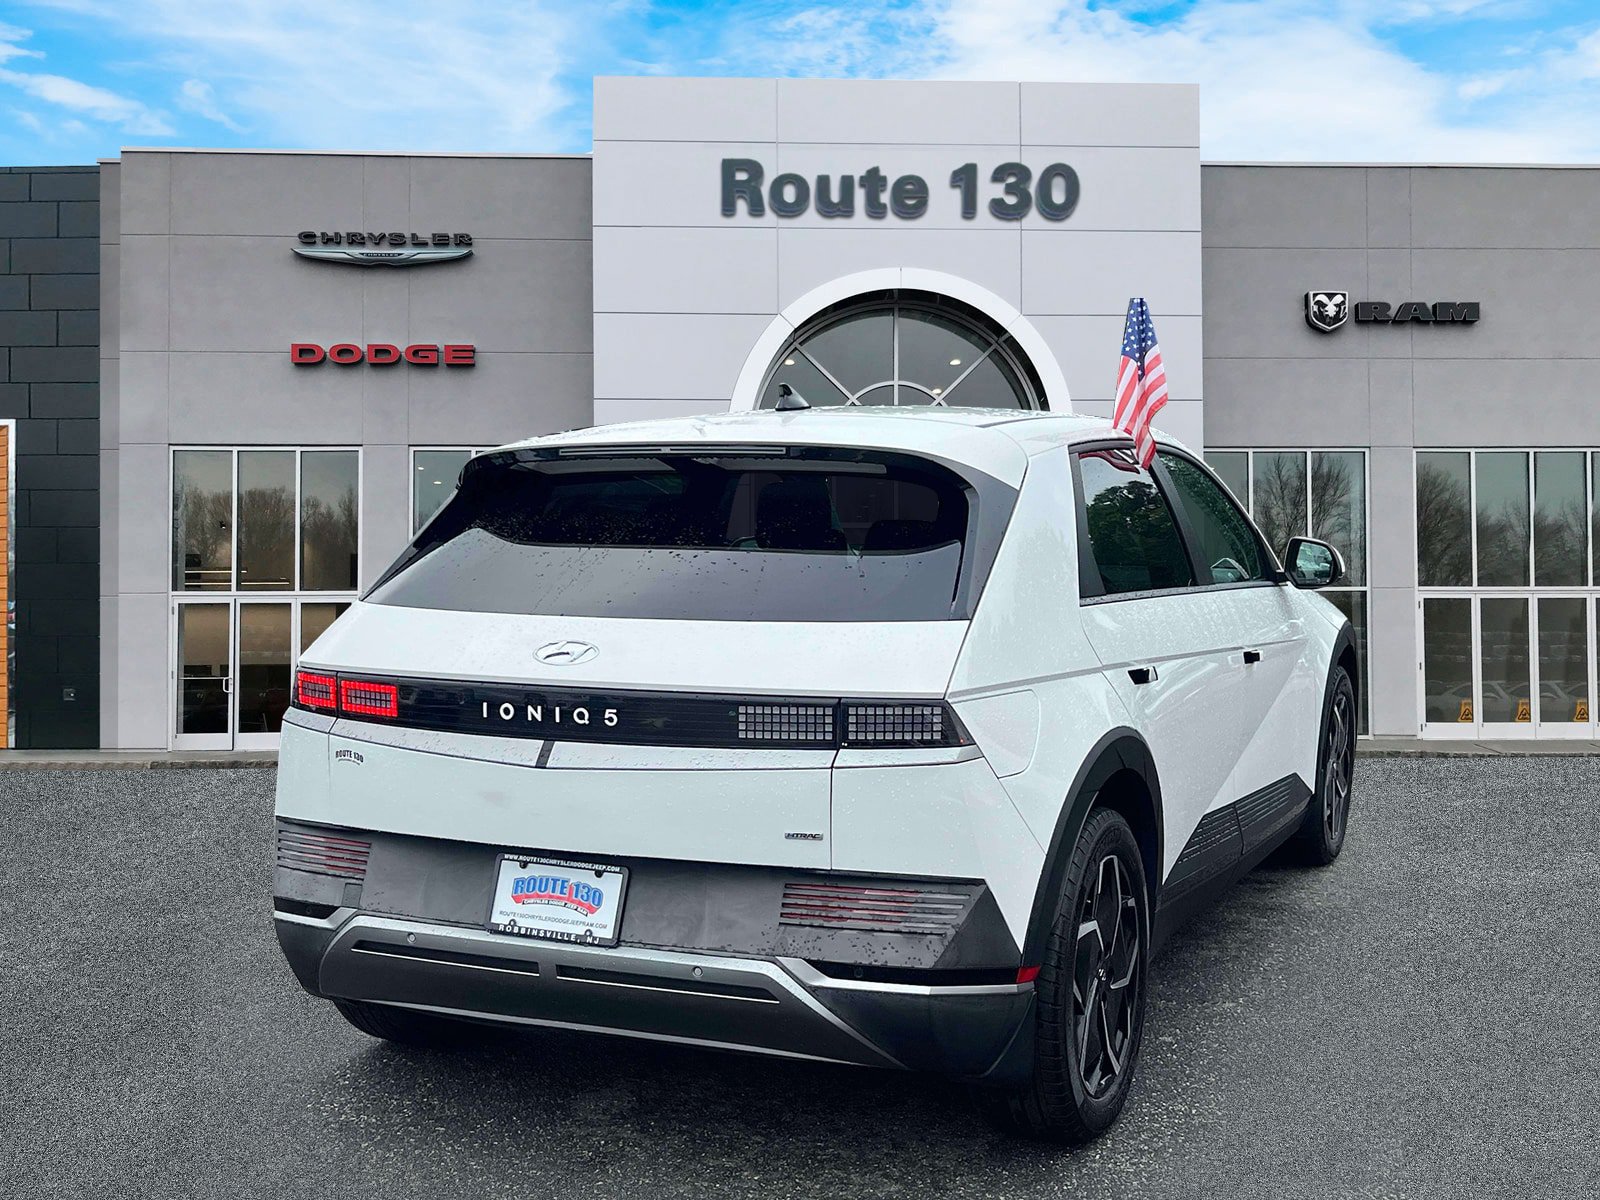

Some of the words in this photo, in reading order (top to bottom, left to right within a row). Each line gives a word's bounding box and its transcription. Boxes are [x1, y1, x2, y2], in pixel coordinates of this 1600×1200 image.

[720, 157, 930, 218] Route
[949, 161, 1081, 221] 130
[298, 231, 473, 246] CHRYSLER
[1354, 302, 1480, 324] RAM
[290, 343, 476, 366] DODGE
[482, 702, 590, 725] IONIQ
[604, 708, 618, 727] 5
[335, 749, 352, 758] ROUTE
[511, 875, 570, 896] ROUTE
[573, 880, 604, 909] 130
[498, 924, 580, 943] ROBBINSVILLE,
[586, 935, 600, 945] NJ
